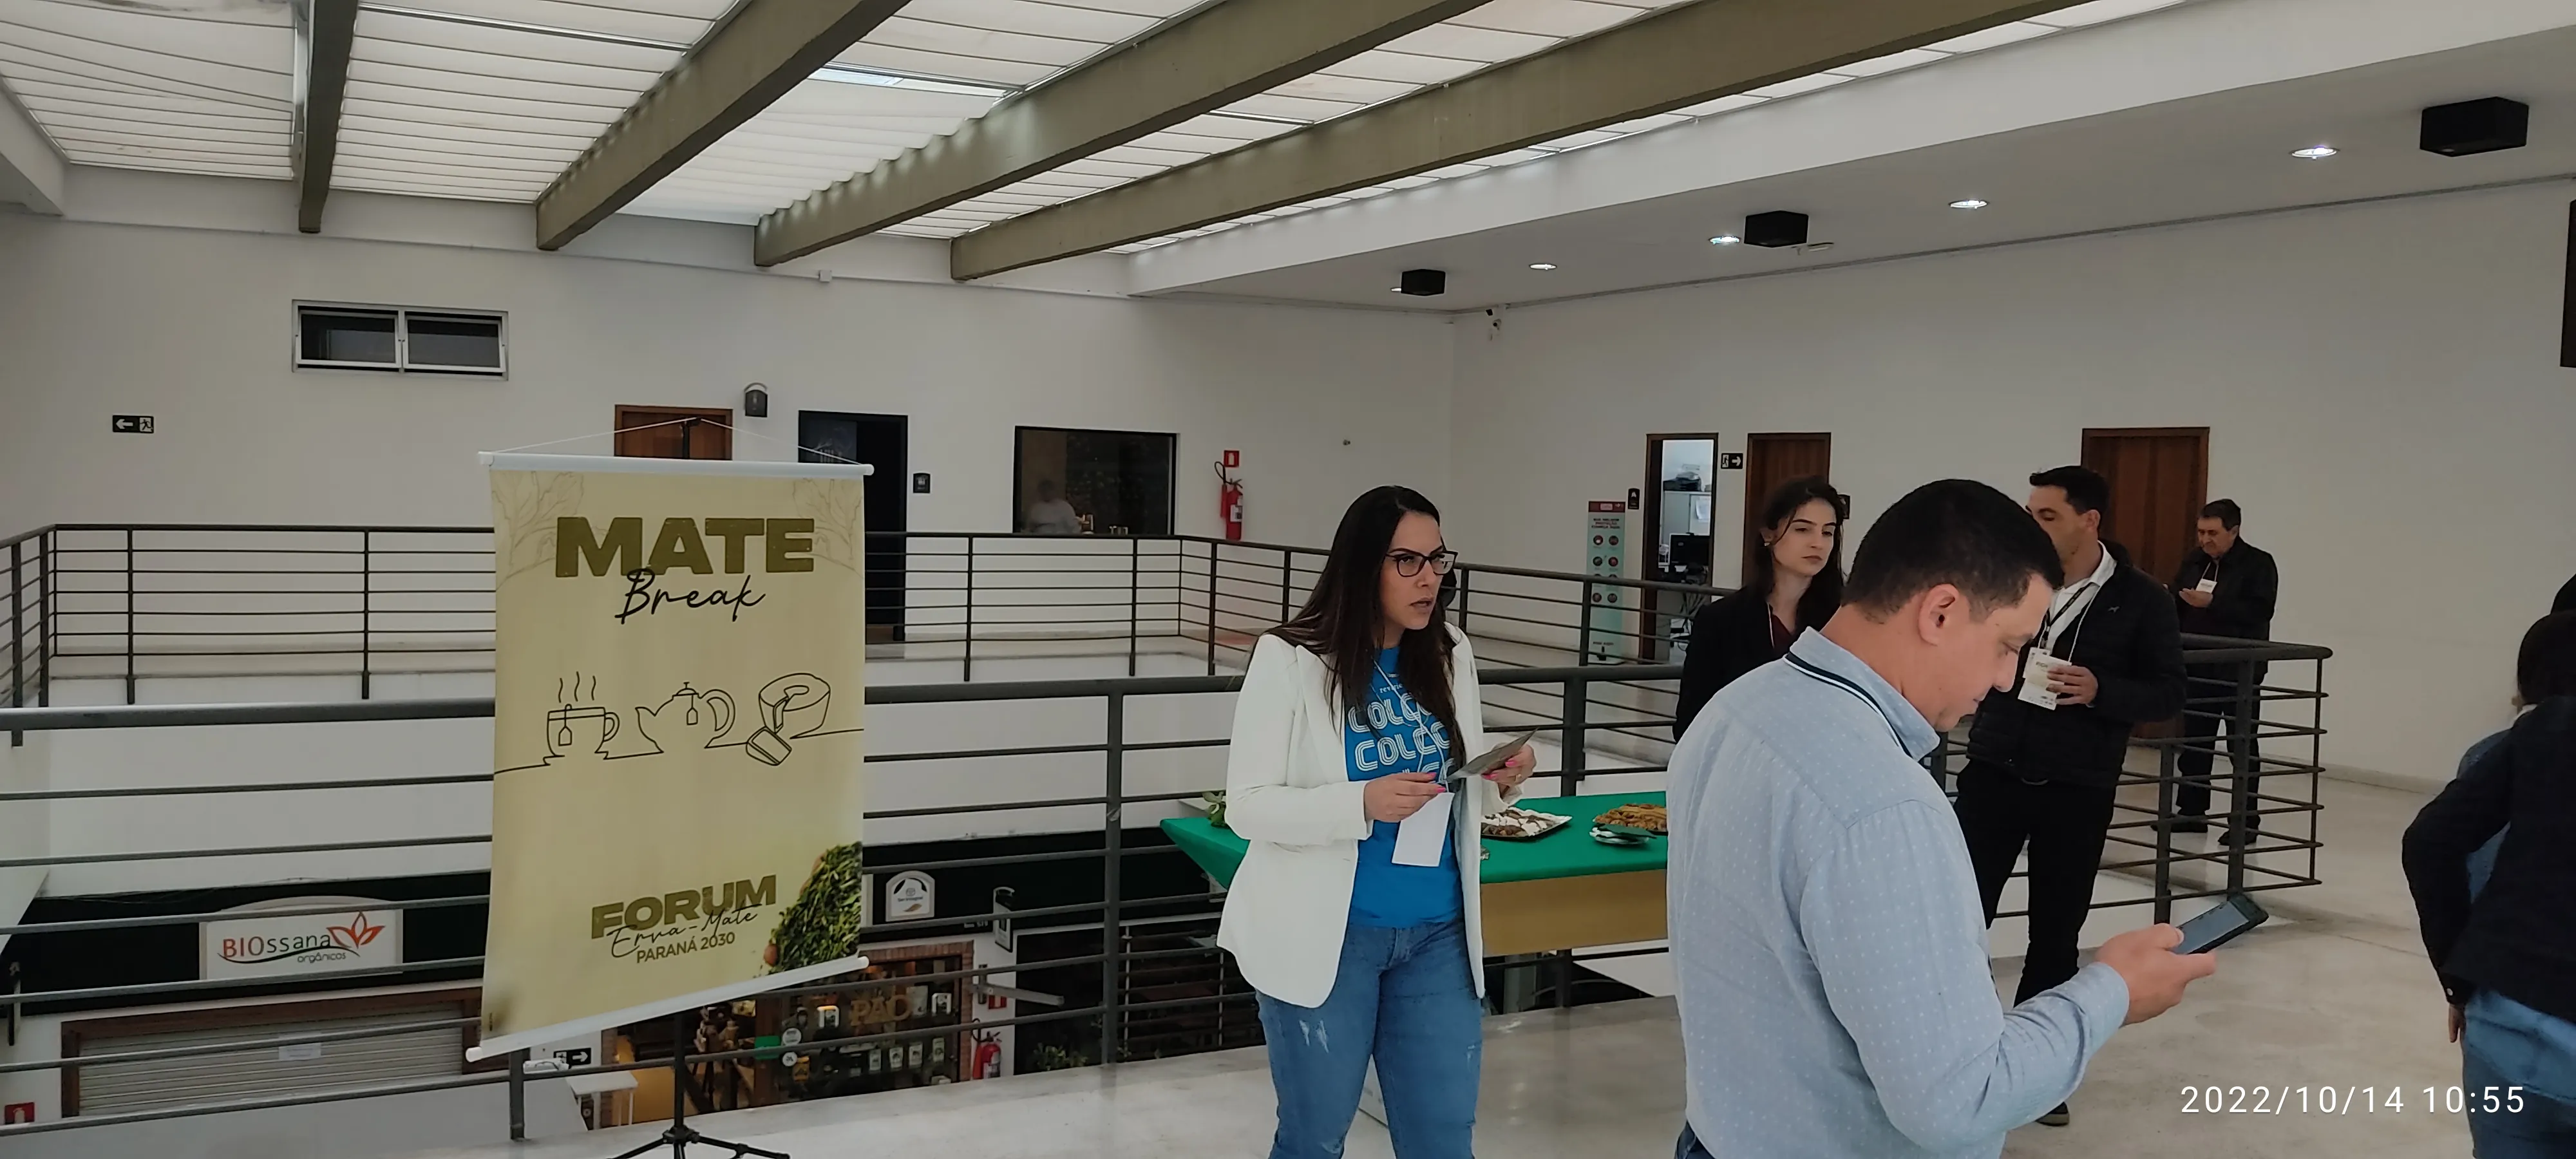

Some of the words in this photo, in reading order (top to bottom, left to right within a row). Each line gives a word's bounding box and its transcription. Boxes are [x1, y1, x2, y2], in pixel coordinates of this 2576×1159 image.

[556, 517, 815, 577] MATE
[615, 568, 765, 624] Break
[591, 874, 777, 939] FORUM
[223, 934, 331, 959] BIOssana
[297, 952, 346, 964] orgânicos
[636, 936, 697, 964] PARANÁ
[700, 932, 735, 950] 2030
